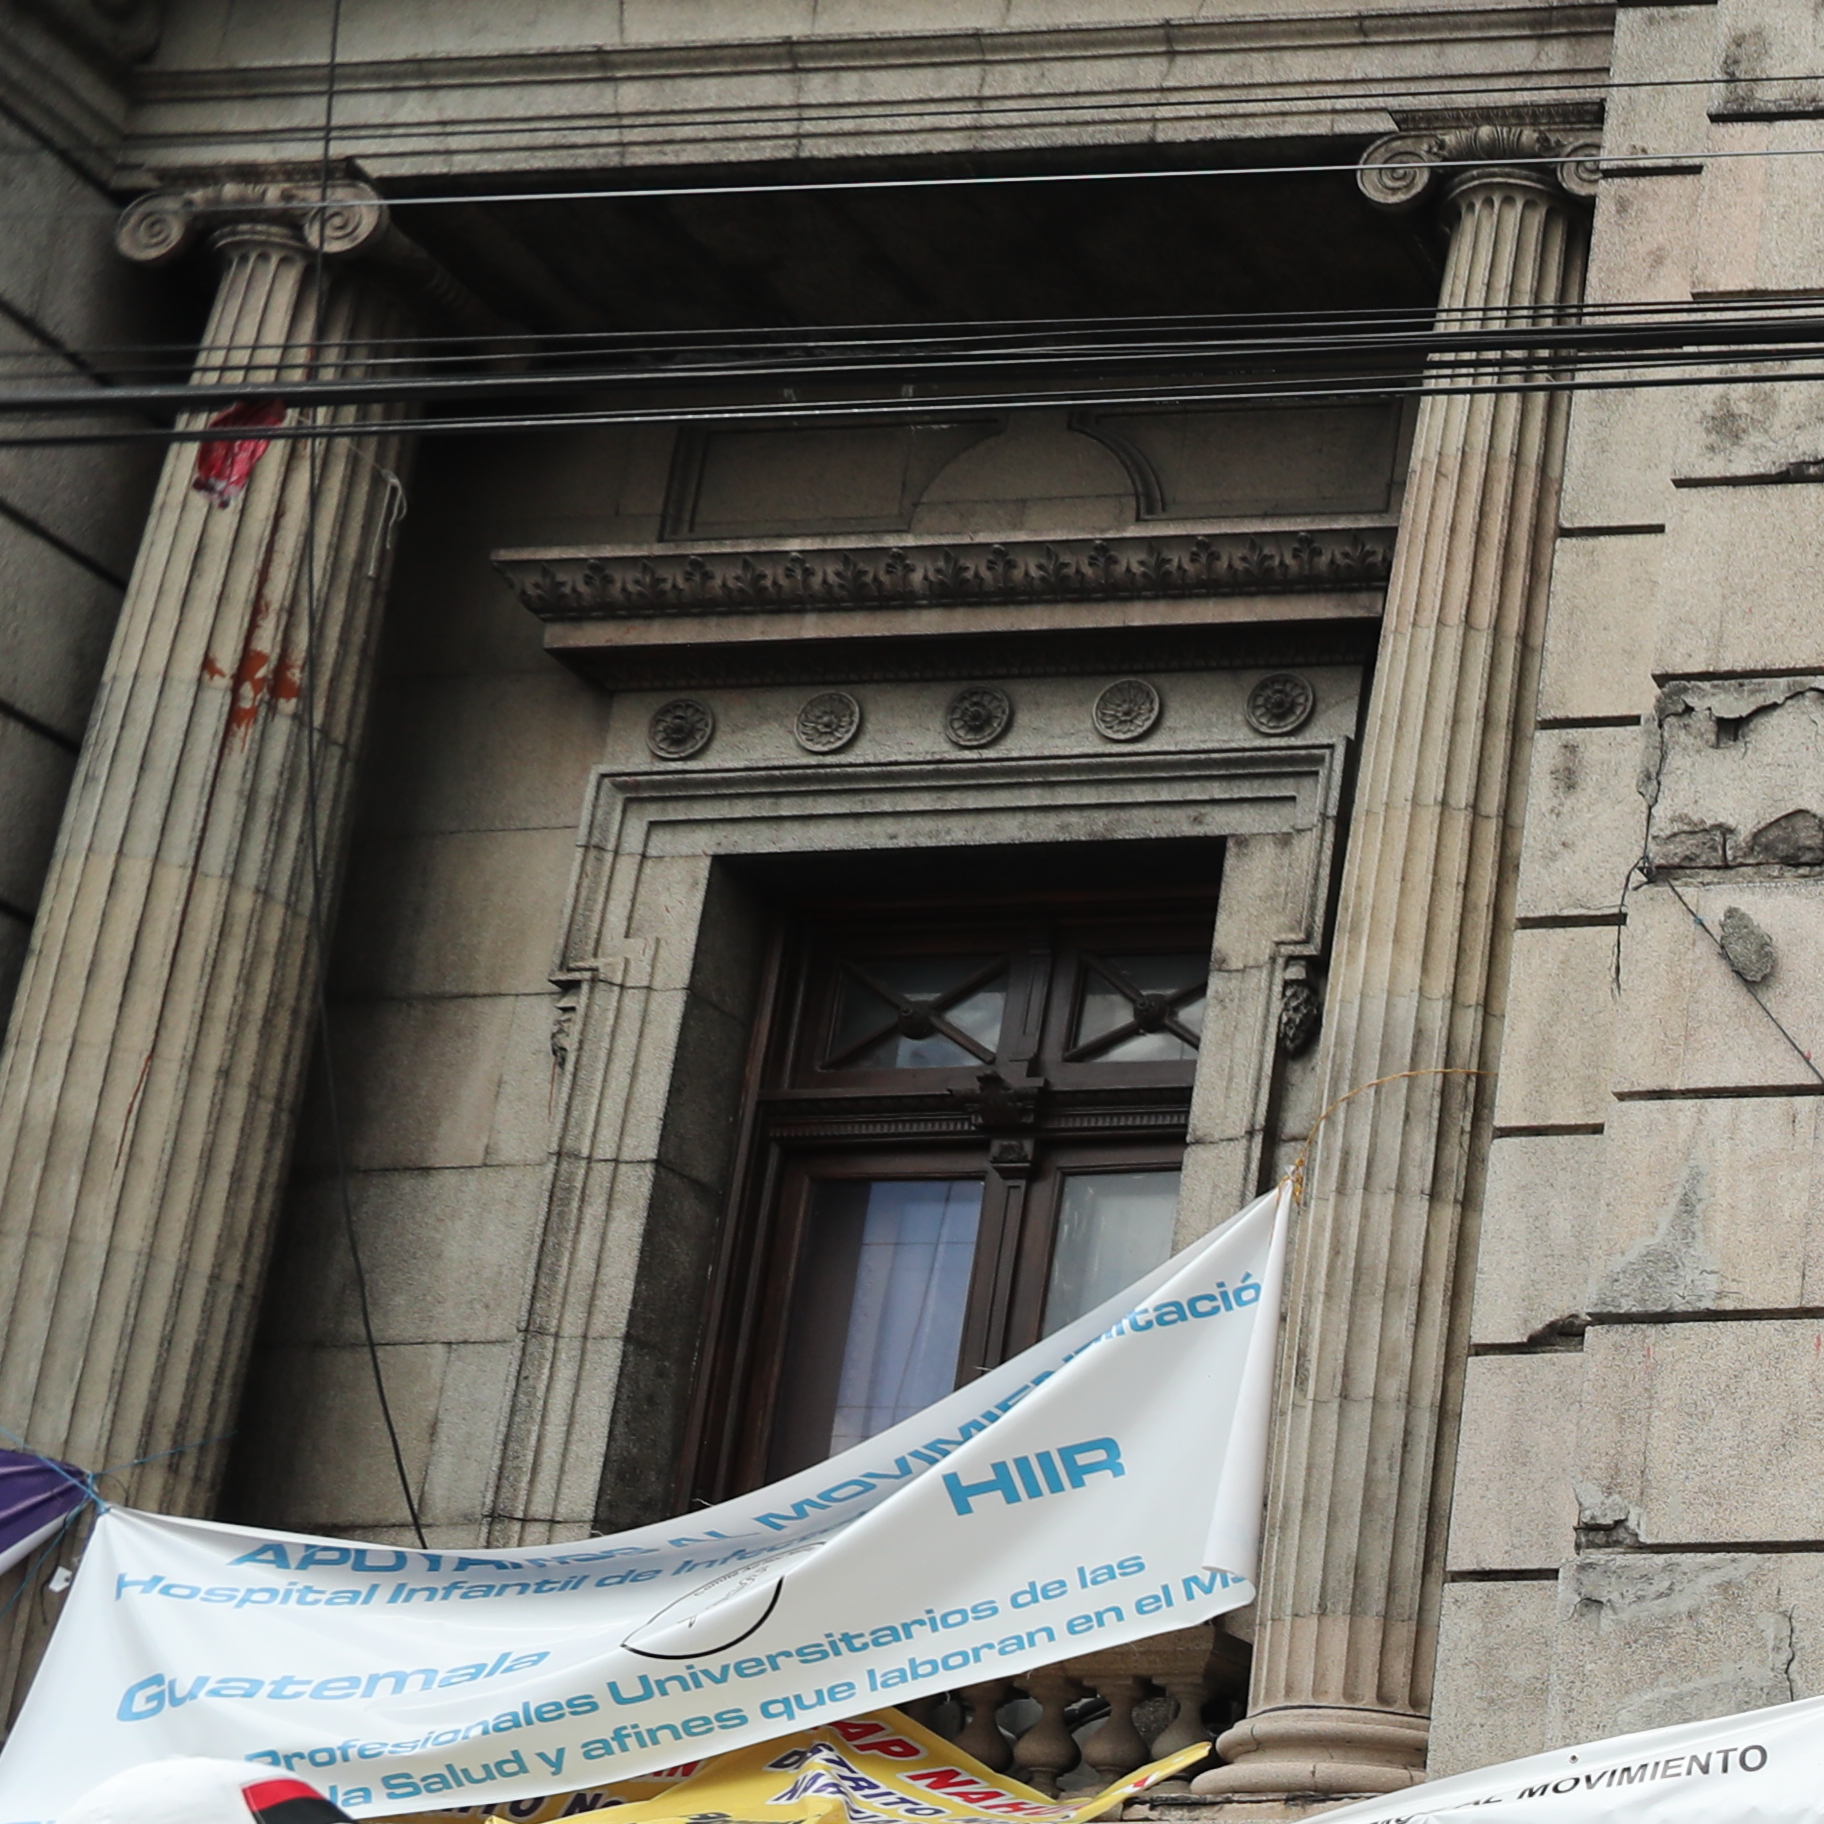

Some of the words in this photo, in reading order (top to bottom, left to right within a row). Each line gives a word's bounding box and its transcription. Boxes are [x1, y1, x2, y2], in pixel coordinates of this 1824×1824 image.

[942, 1435, 1127, 1516] HIIR
[115, 1572, 379, 1609] Hospital
[387, 1573, 588, 1607] Infantil
[594, 1565, 646, 1589] de
[116, 1650, 552, 1722] Guatemala
[244, 1692, 600, 1772] Profesionales
[607, 1598, 1000, 1706] Universitarios
[1009, 1579, 1070, 1618] de
[1076, 1553, 1148, 1590] las
[380, 1746, 528, 1803] Salud
[536, 1746, 567, 1776] y
[580, 1710, 750, 1762] afines
[759, 1678, 857, 1723] que
[866, 1625, 1056, 1691] laboran
[1066, 1602, 1126, 1636] en
[1133, 1584, 1174, 1617] el
[1516, 1743, 1769, 1802] MOVIMIENTO
